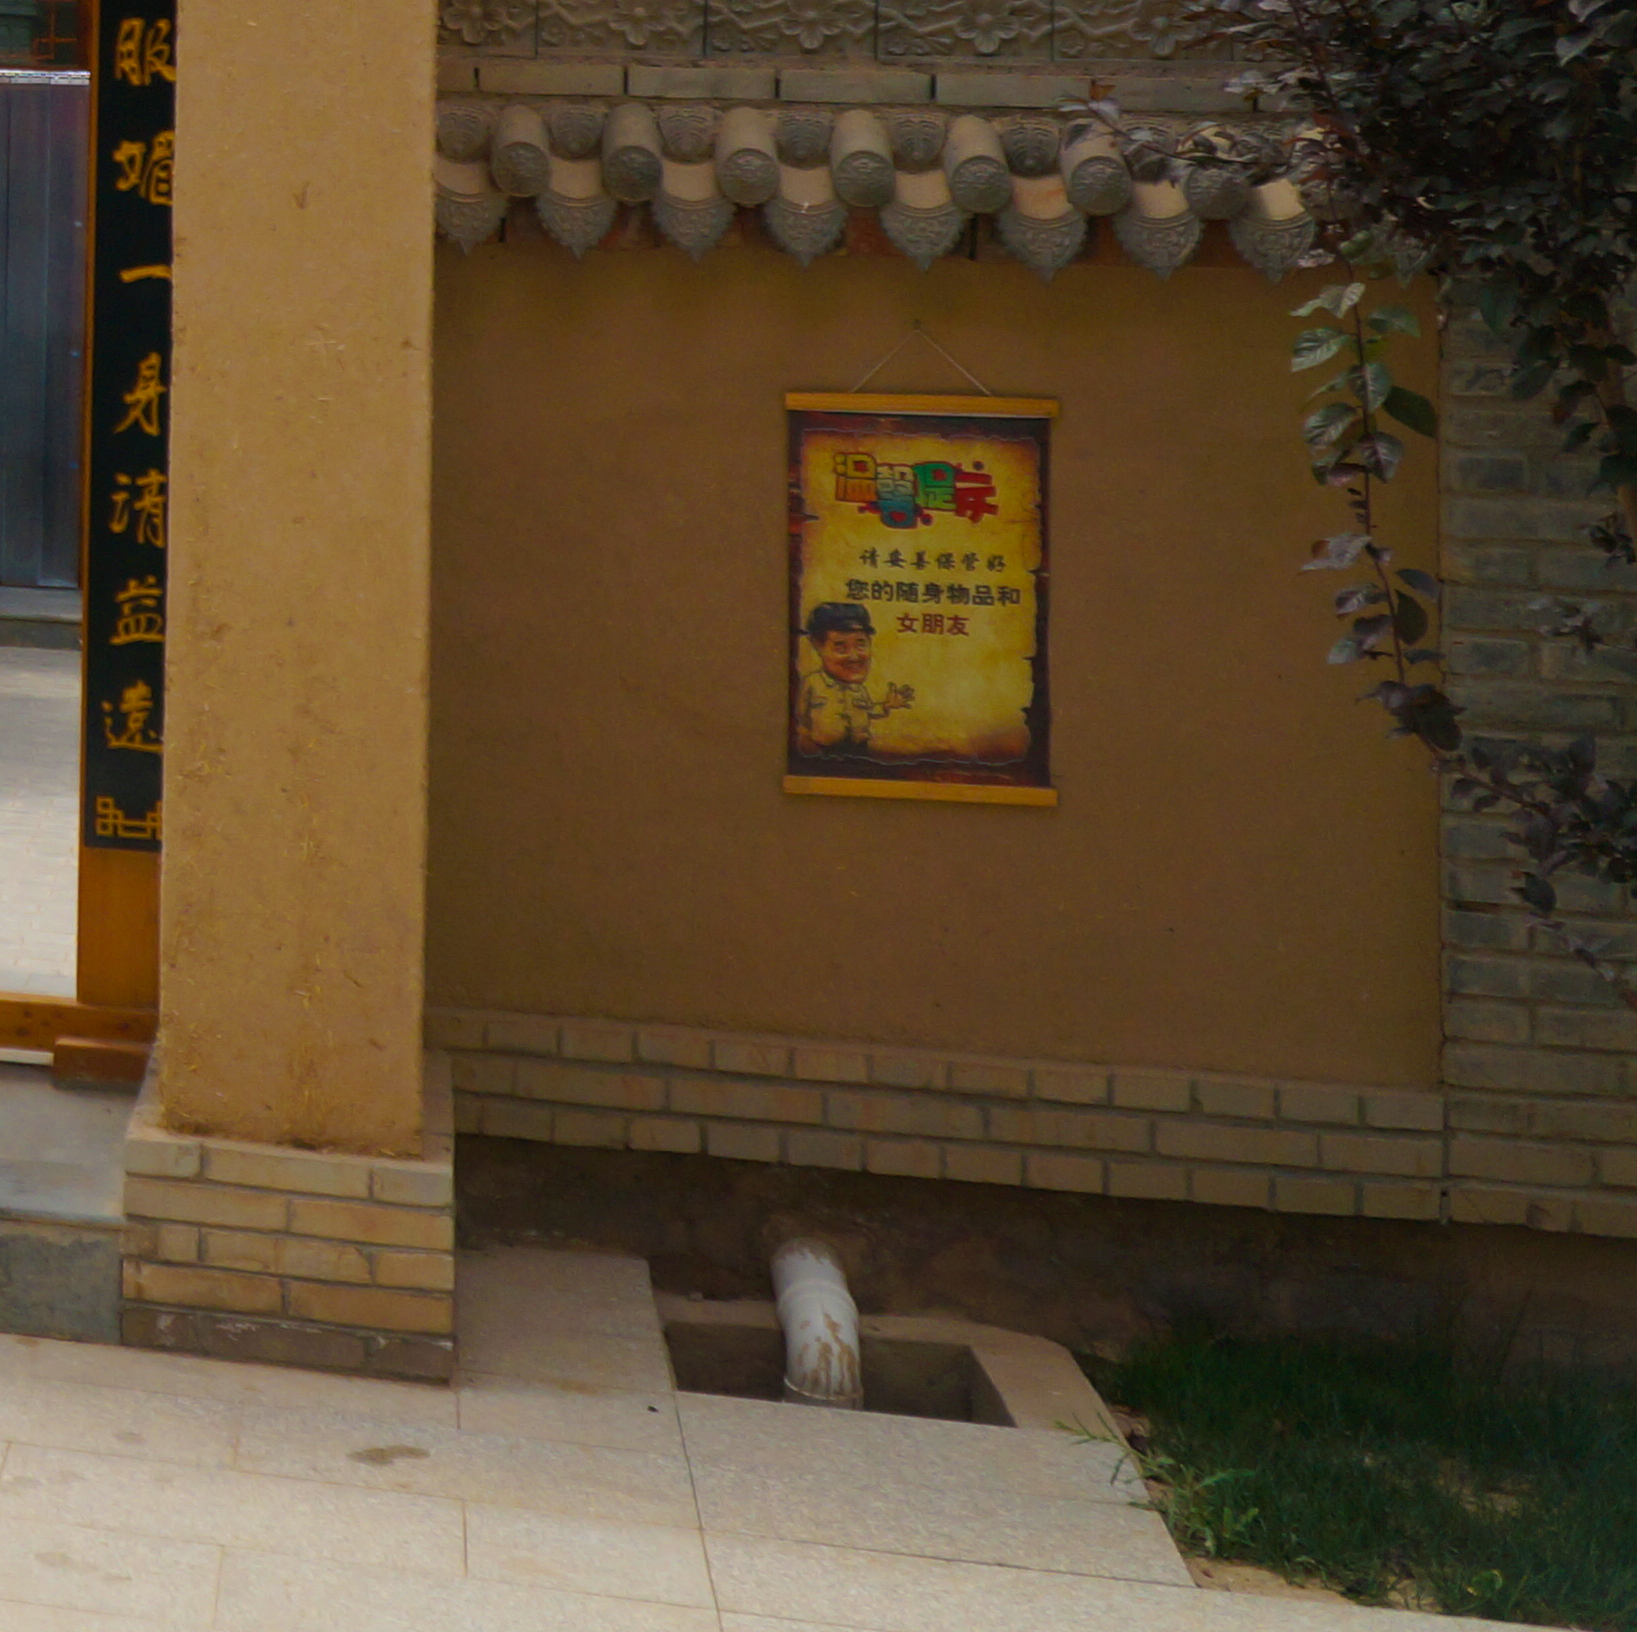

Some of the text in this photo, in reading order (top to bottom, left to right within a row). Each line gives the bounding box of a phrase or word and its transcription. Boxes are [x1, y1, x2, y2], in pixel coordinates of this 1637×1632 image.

[859, 548, 1007, 574] 请妥善保管好
[845, 579, 1021, 608] 您的随身物品和
[896, 613, 971, 638] 女朋友
